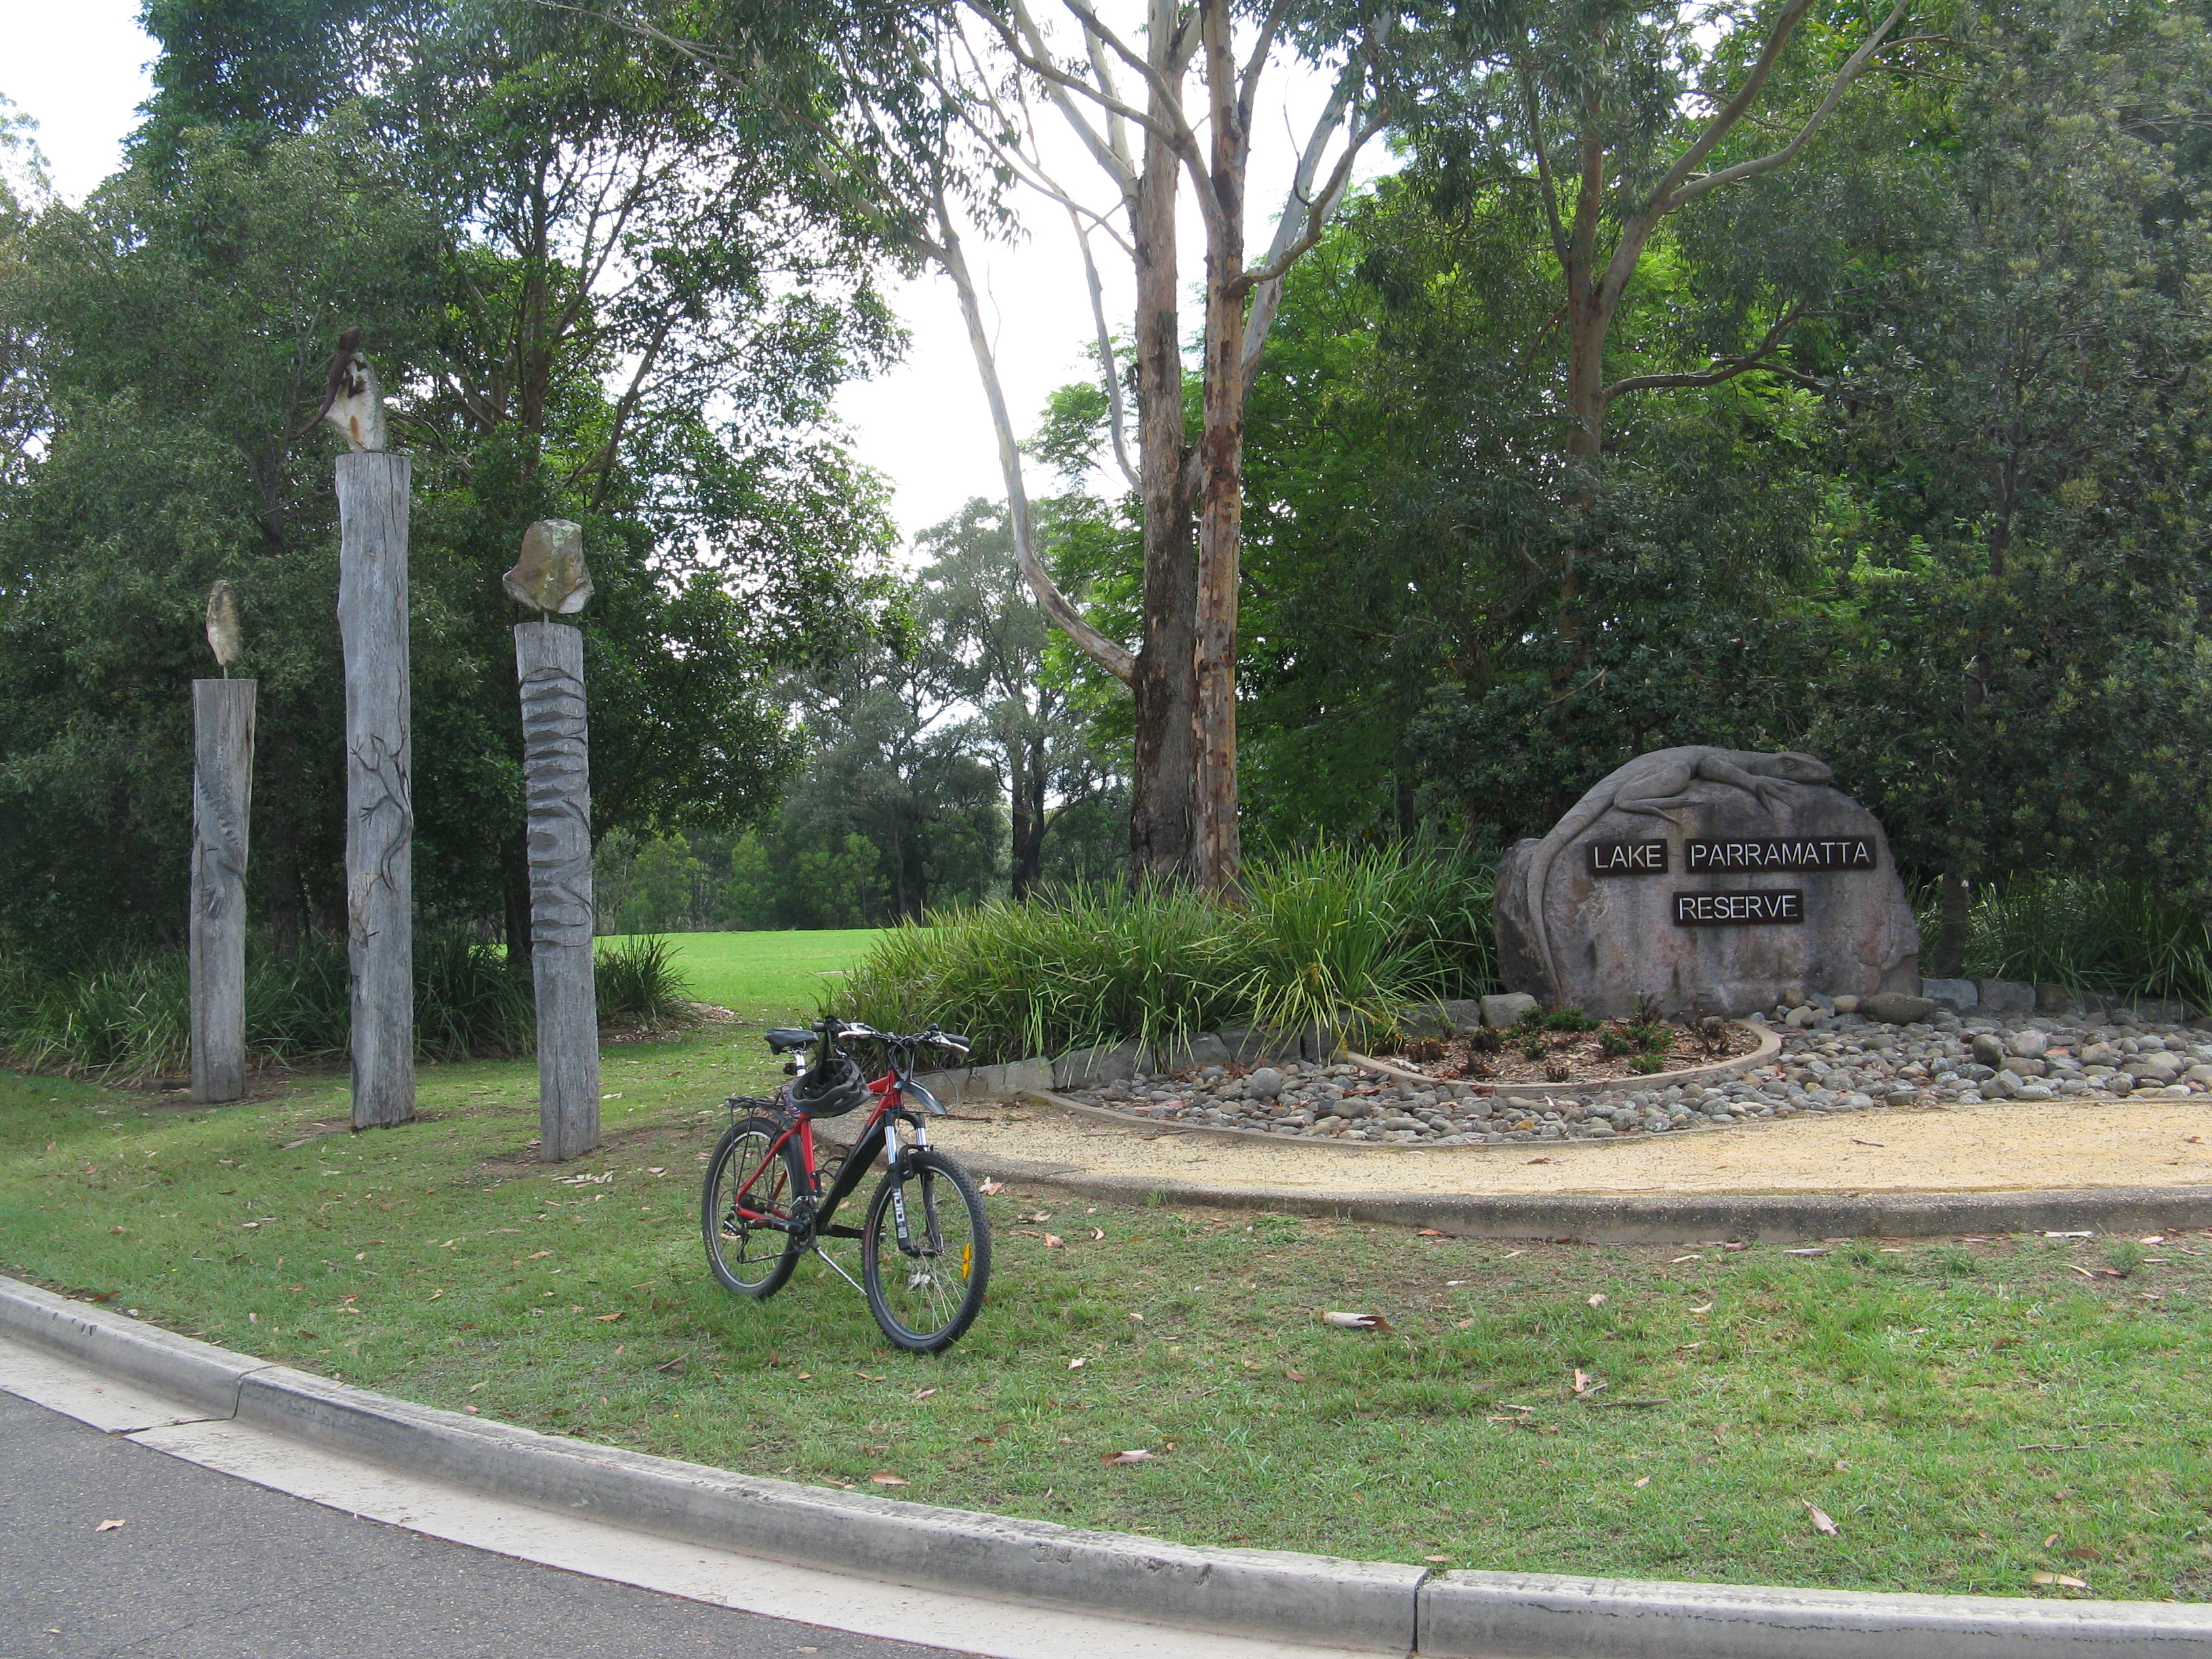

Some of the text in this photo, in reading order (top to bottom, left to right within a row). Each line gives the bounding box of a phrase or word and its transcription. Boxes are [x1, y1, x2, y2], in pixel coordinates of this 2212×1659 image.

[1594, 841, 1870, 869] LAKE PARRAMATTA
[1679, 895, 1798, 920] RESERVE
